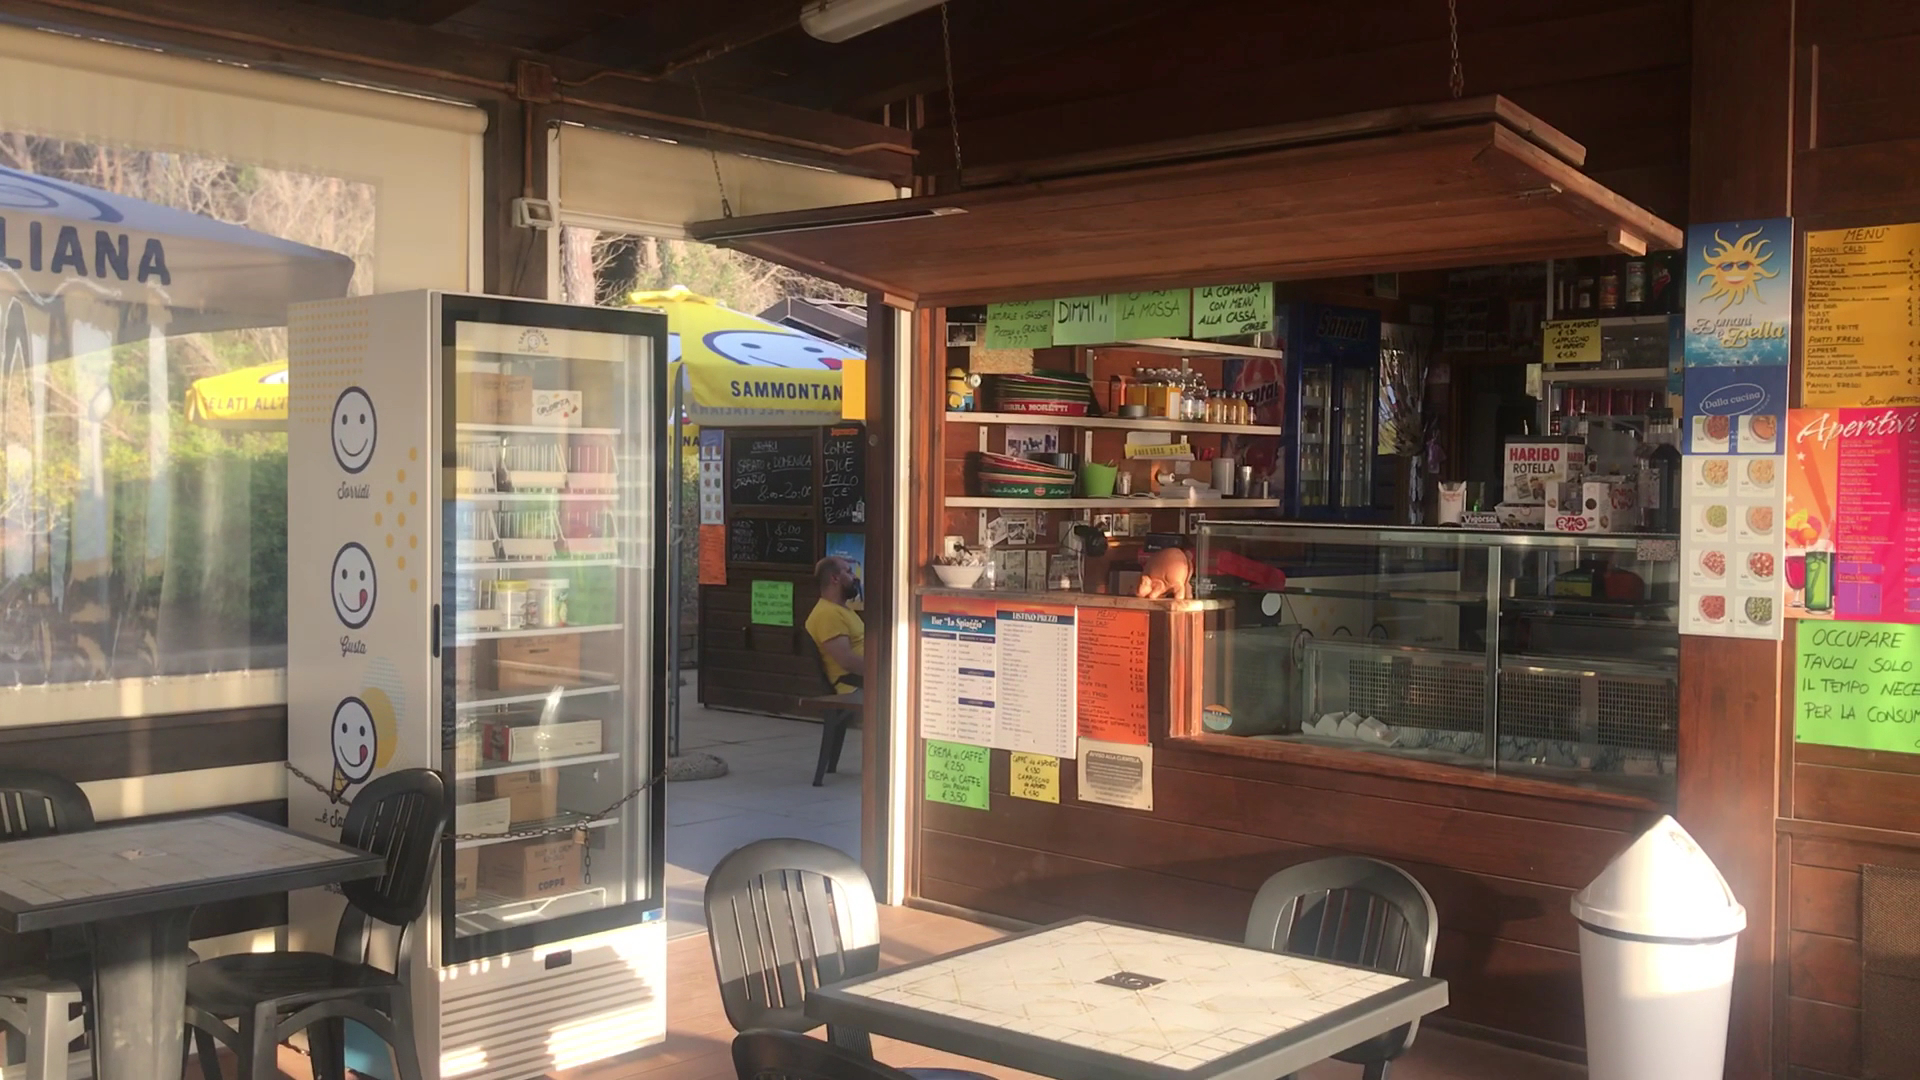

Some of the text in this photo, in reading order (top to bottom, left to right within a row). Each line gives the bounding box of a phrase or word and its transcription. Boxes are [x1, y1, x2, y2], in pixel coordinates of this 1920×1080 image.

[1202, 287, 1213, 298] LA
[1122, 300, 1180, 320] LA MOSSA
[1209, 301, 1226, 312] CON
[1198, 309, 1257, 325] ALLA CASSA
[1692, 314, 1752, 335] Domani
[1722, 321, 1784, 349] Bella
[730, 380, 842, 401] SAMMONTAN
[1028, 404, 1068, 412] MORETTI
[1705, 392, 1760, 410] Dalla cucina
[1796, 410, 1919, 450] Aperitivi
[824, 441, 855, 455] COME
[1509, 447, 1560, 462] HARIBO
[825, 457, 854, 473] DICE
[1513, 463, 1555, 474] ROTELLA
[337, 481, 370, 499] Sorridi
[824, 496, 835, 506] DI
[1012, 612, 1036, 621] LISTINO
[1812, 628, 1905, 648] OCCUPARE
[340, 635, 367, 658] Gusta
[1803, 653, 1912, 673] TAVOLI SOLO
[1802, 678, 1815, 691] IL
[1820, 678, 1869, 694] TEMPO
[1804, 702, 1832, 719] PER
[1841, 704, 1855, 719] LA
[928, 745, 951, 758] CREMA
[928, 770, 948, 781] CREMA
[538, 877, 565, 890] COPPE
